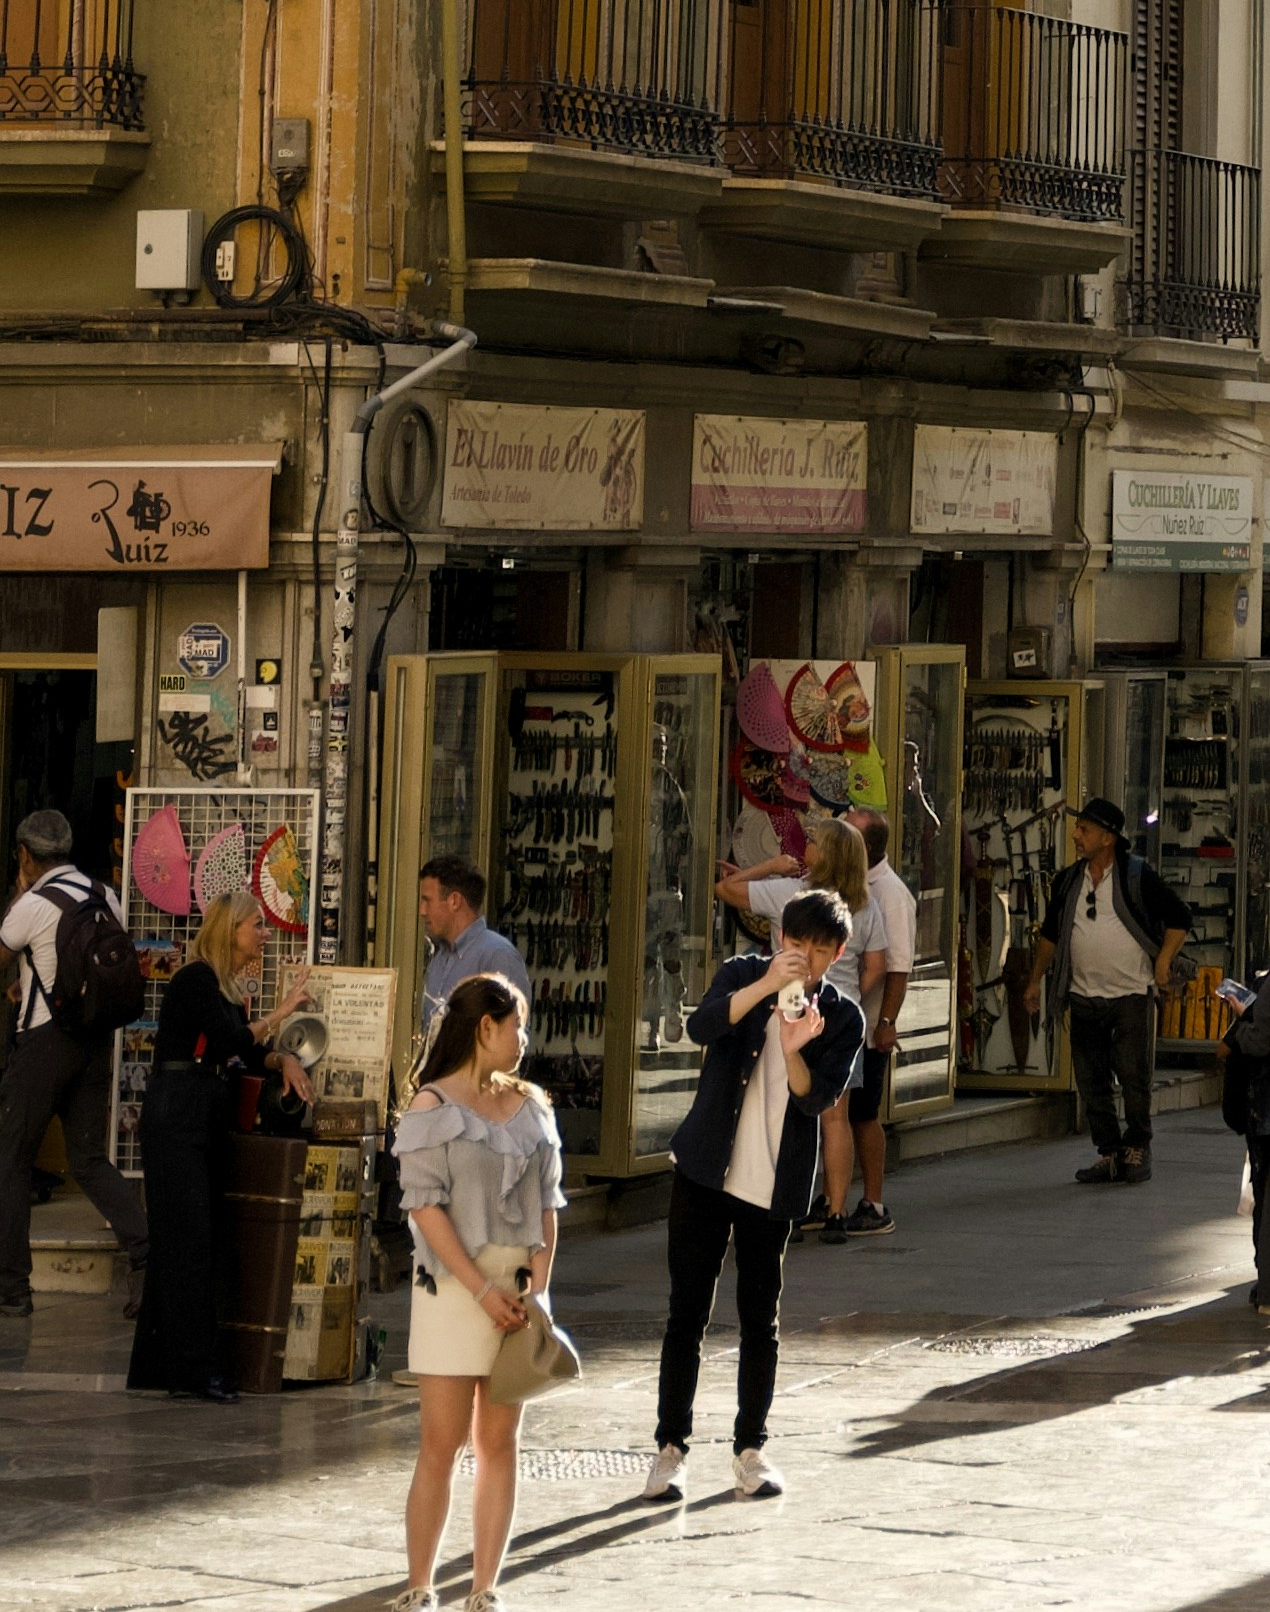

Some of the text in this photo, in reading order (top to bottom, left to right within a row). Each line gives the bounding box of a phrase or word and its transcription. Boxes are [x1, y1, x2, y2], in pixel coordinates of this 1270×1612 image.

[539, 433, 560, 473] de
[564, 435, 598, 474] Oro
[171, 521, 210, 537] 1936
[160, 676, 185, 691] HARD
